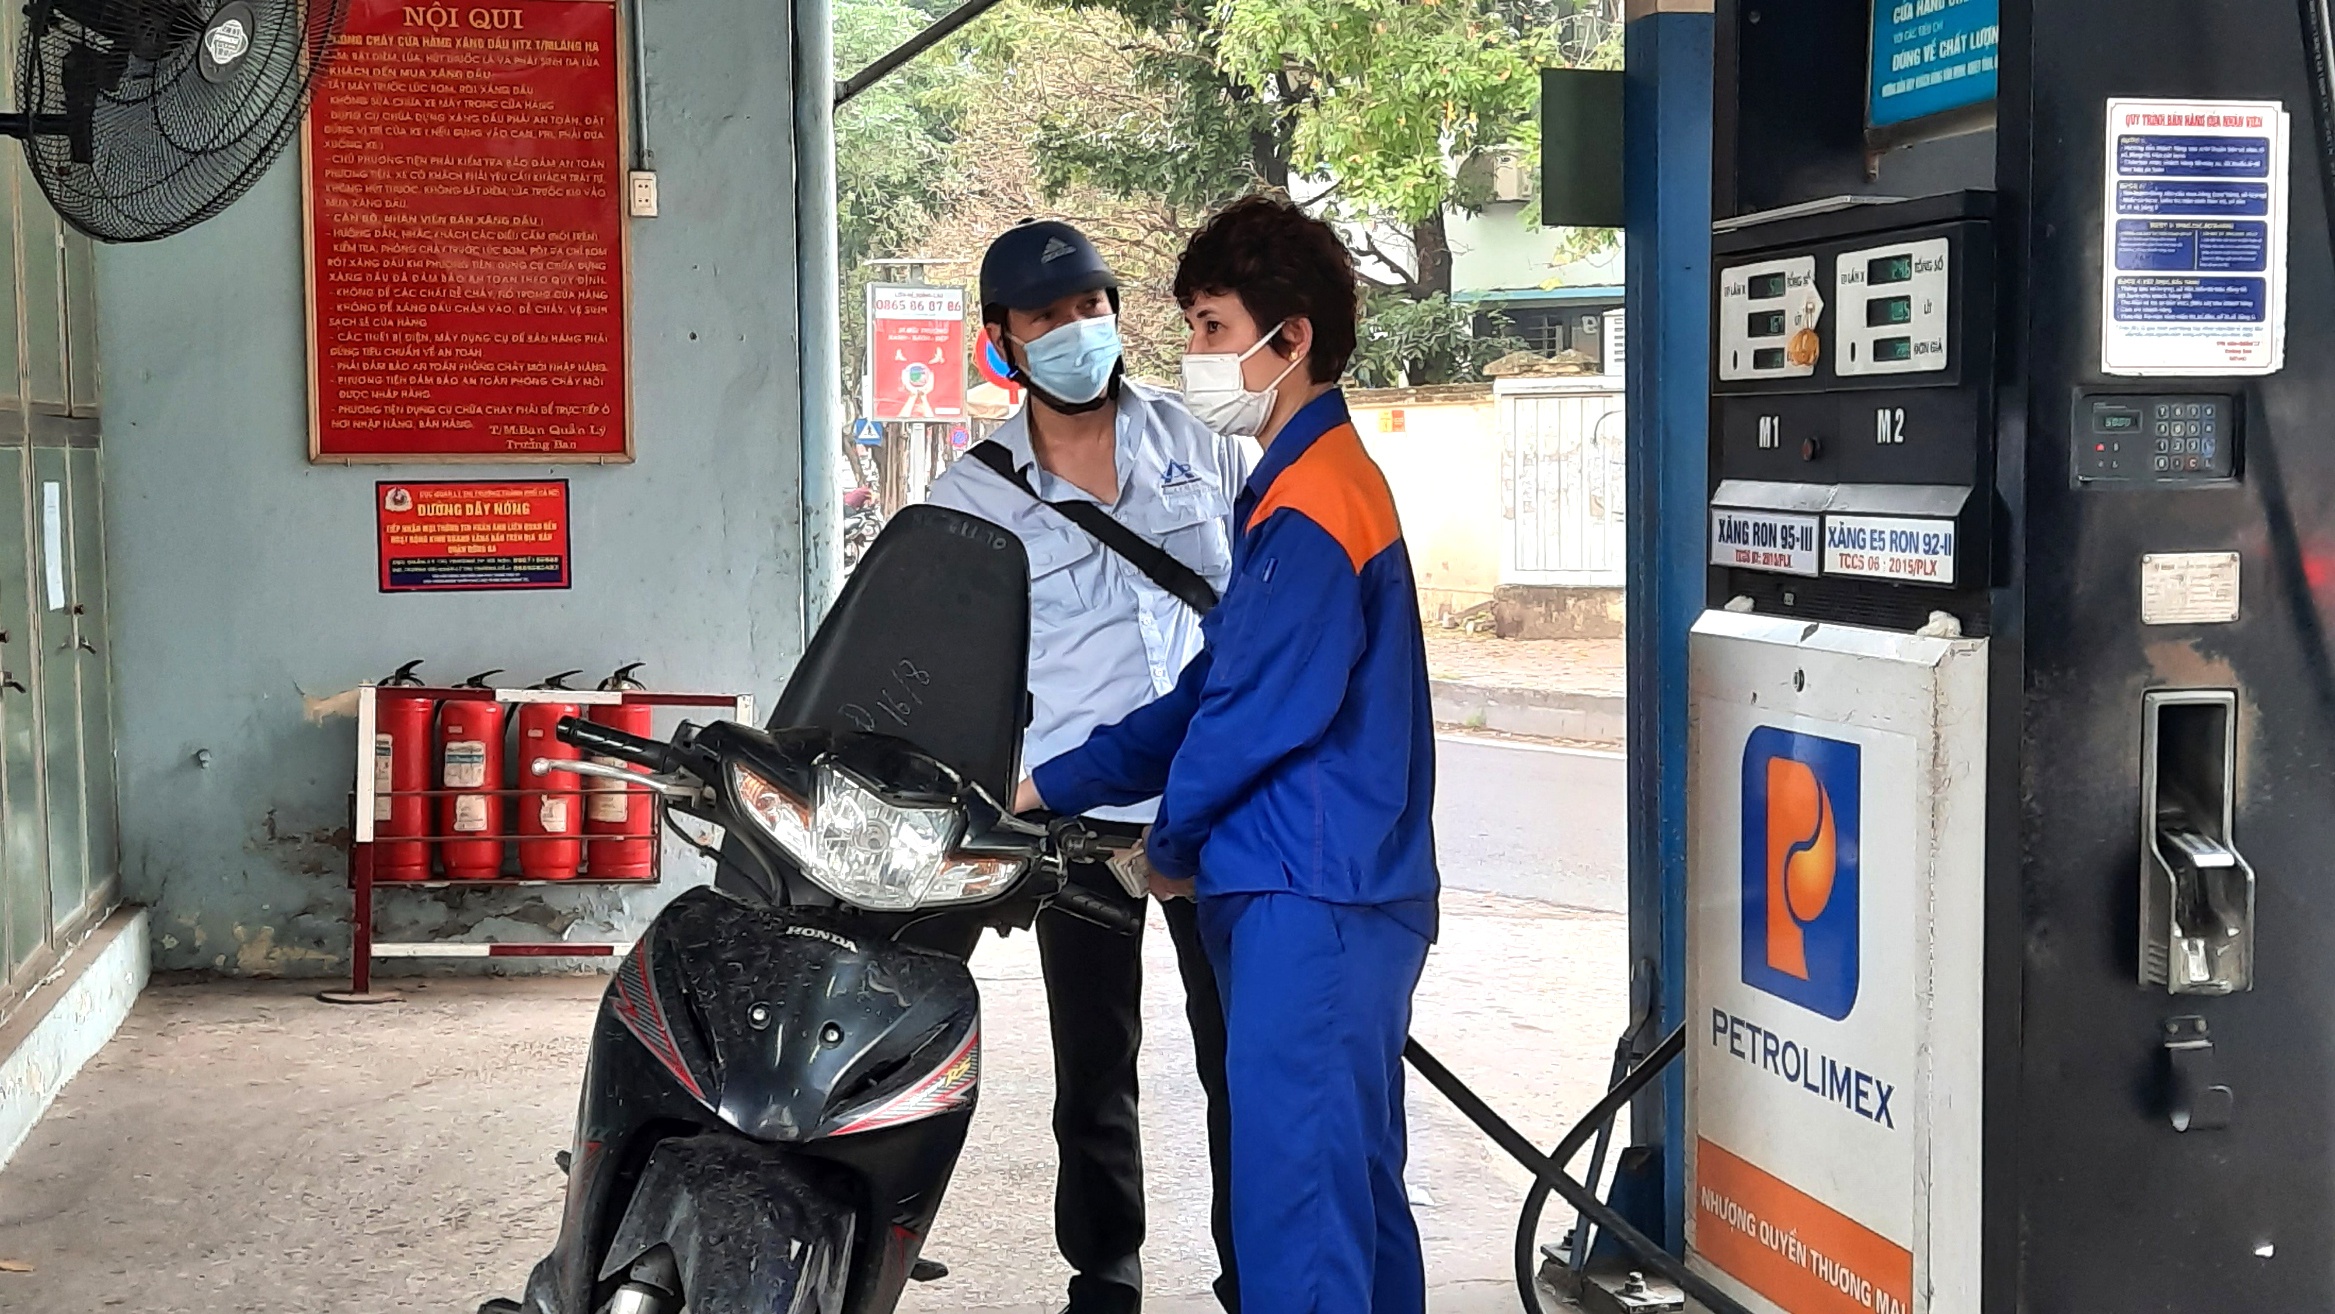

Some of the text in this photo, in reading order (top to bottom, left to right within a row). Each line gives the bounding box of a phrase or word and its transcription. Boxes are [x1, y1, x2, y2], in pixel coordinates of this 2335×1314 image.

[402, 1, 525, 34] NỘI QUI
[1970, 24, 1999, 51] LƯỢN
[1718, 514, 1813, 552] XĂNG RON 95-III
[1828, 520, 1952, 557] XĂNG E5 RON 92-II
[1838, 552, 1865, 571] TCCS
[1888, 557, 1938, 577] 2015/PLX
[785, 926, 859, 954] HONDA
[1712, 1006, 1896, 1131] PETROLIMEX
[1700, 1185, 1757, 1235] NHƯỢNG
[1758, 1220, 1809, 1270] QUYỀN
[1808, 1248, 1875, 1308] THƯƠNG
